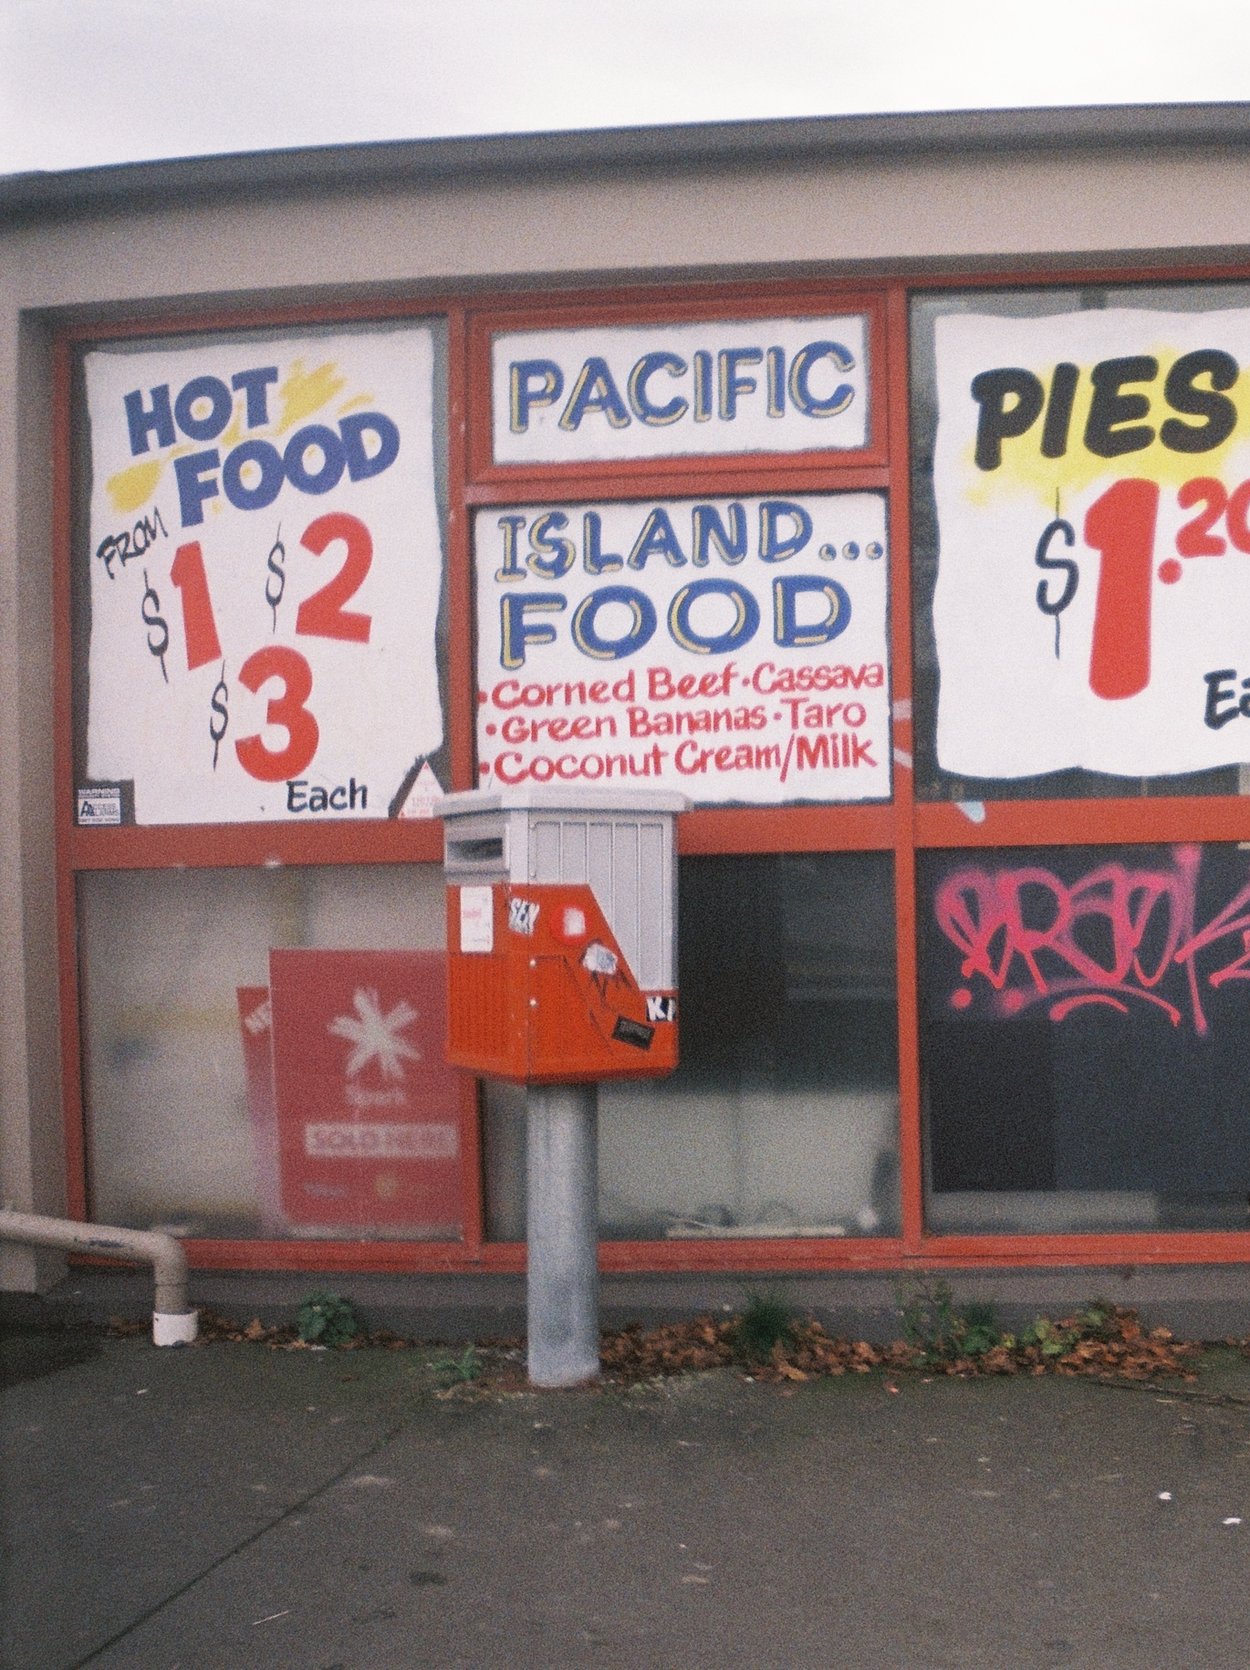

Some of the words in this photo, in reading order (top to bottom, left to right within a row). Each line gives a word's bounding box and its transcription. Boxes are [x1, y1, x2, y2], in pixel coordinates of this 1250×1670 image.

[123, 366, 278, 456] HOT
[509, 341, 855, 434] PACIFIC
[971, 349, 1239, 472] PIES
[174, 412, 401, 528] FOOD
[96, 506, 169, 579] FROM
[500, 574, 852, 670] FOOD
[491, 669, 636, 710] Corned
[647, 662, 738, 701] Beef
[749, 662, 884, 695] Cassava
[501, 714, 618, 744] Green
[626, 704, 767, 739] Bananas
[779, 698, 867, 730] Taro
[286, 778, 368, 812] Each
[494, 742, 669, 785] Coconut
[673, 732, 878, 782] Cream/Milk
